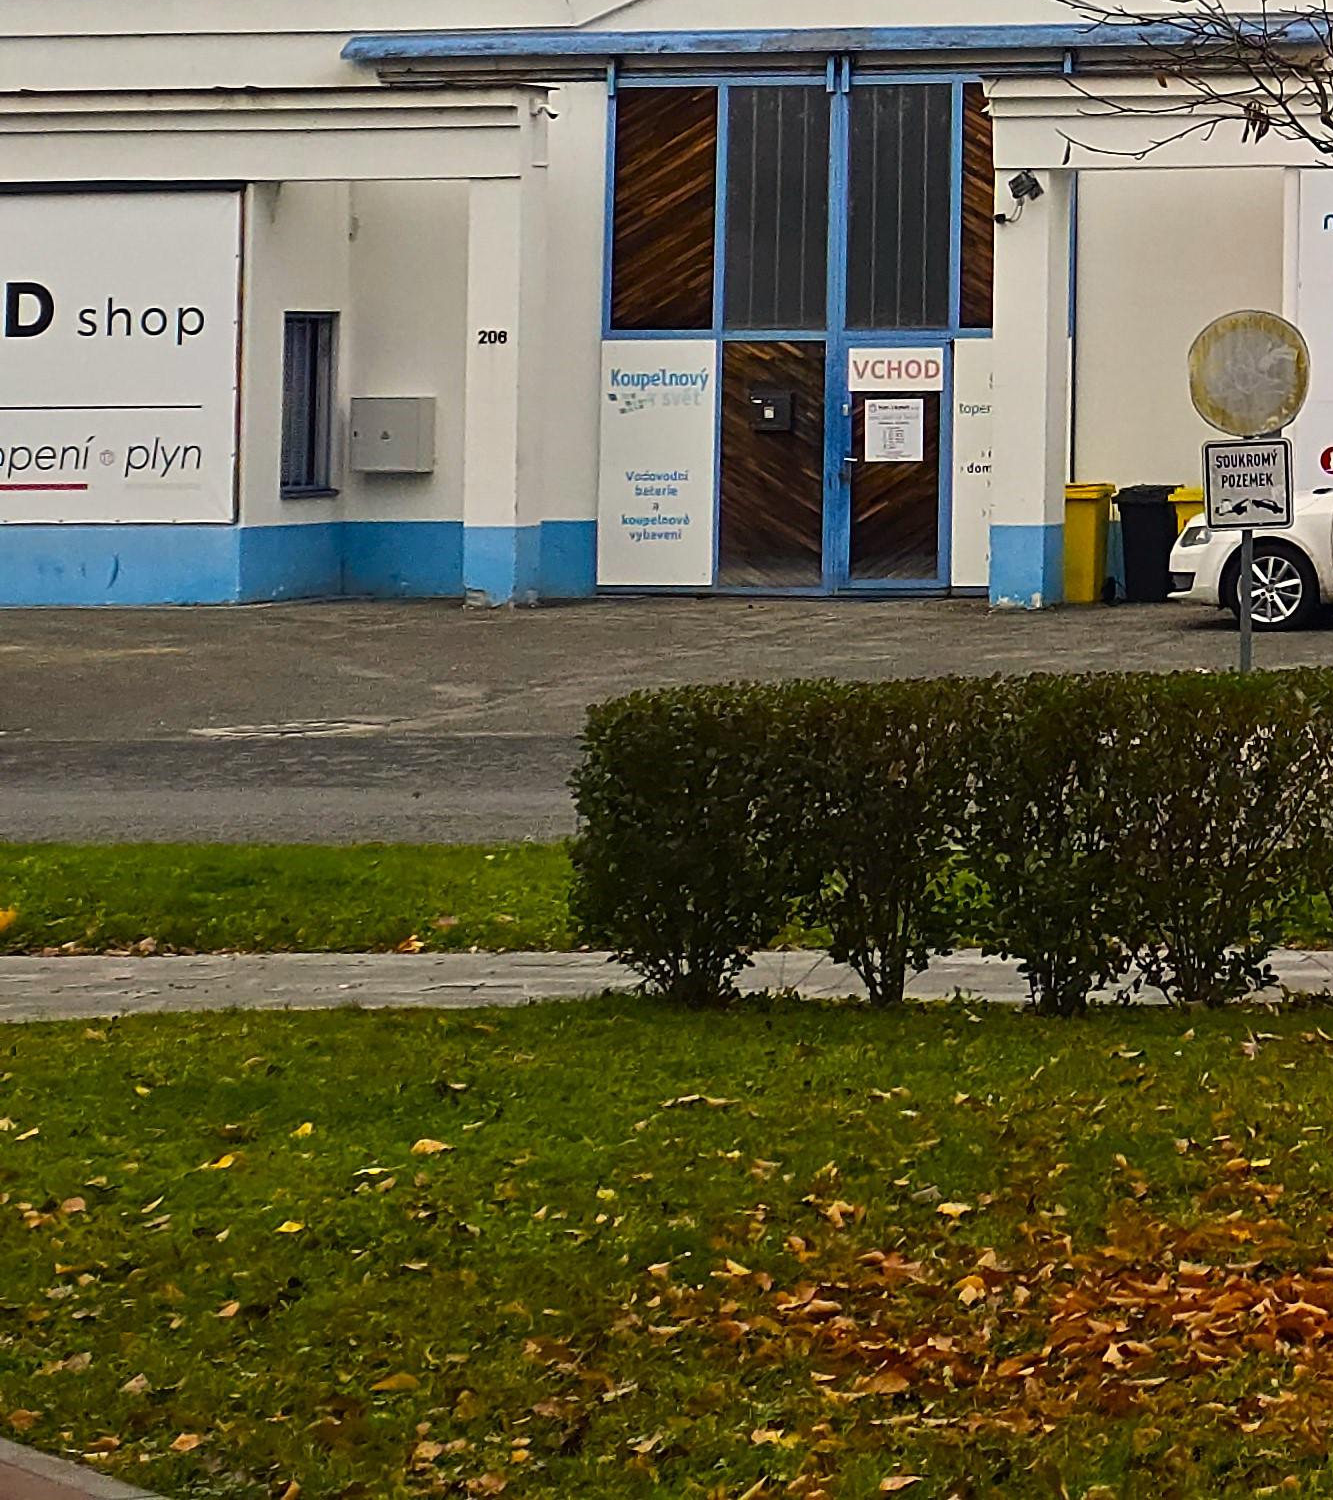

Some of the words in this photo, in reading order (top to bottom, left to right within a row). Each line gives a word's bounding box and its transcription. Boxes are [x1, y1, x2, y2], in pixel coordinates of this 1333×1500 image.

[77, 297, 205, 345] shop
[610, 368, 709, 392] Koupelnový
[852, 359, 940, 380] VCHOD
[0, 435, 96, 479] pení
[124, 436, 203, 478] plyn
[1215, 448, 1278, 469] SOUKROMÝ
[1221, 472, 1274, 489] POZEMEK
